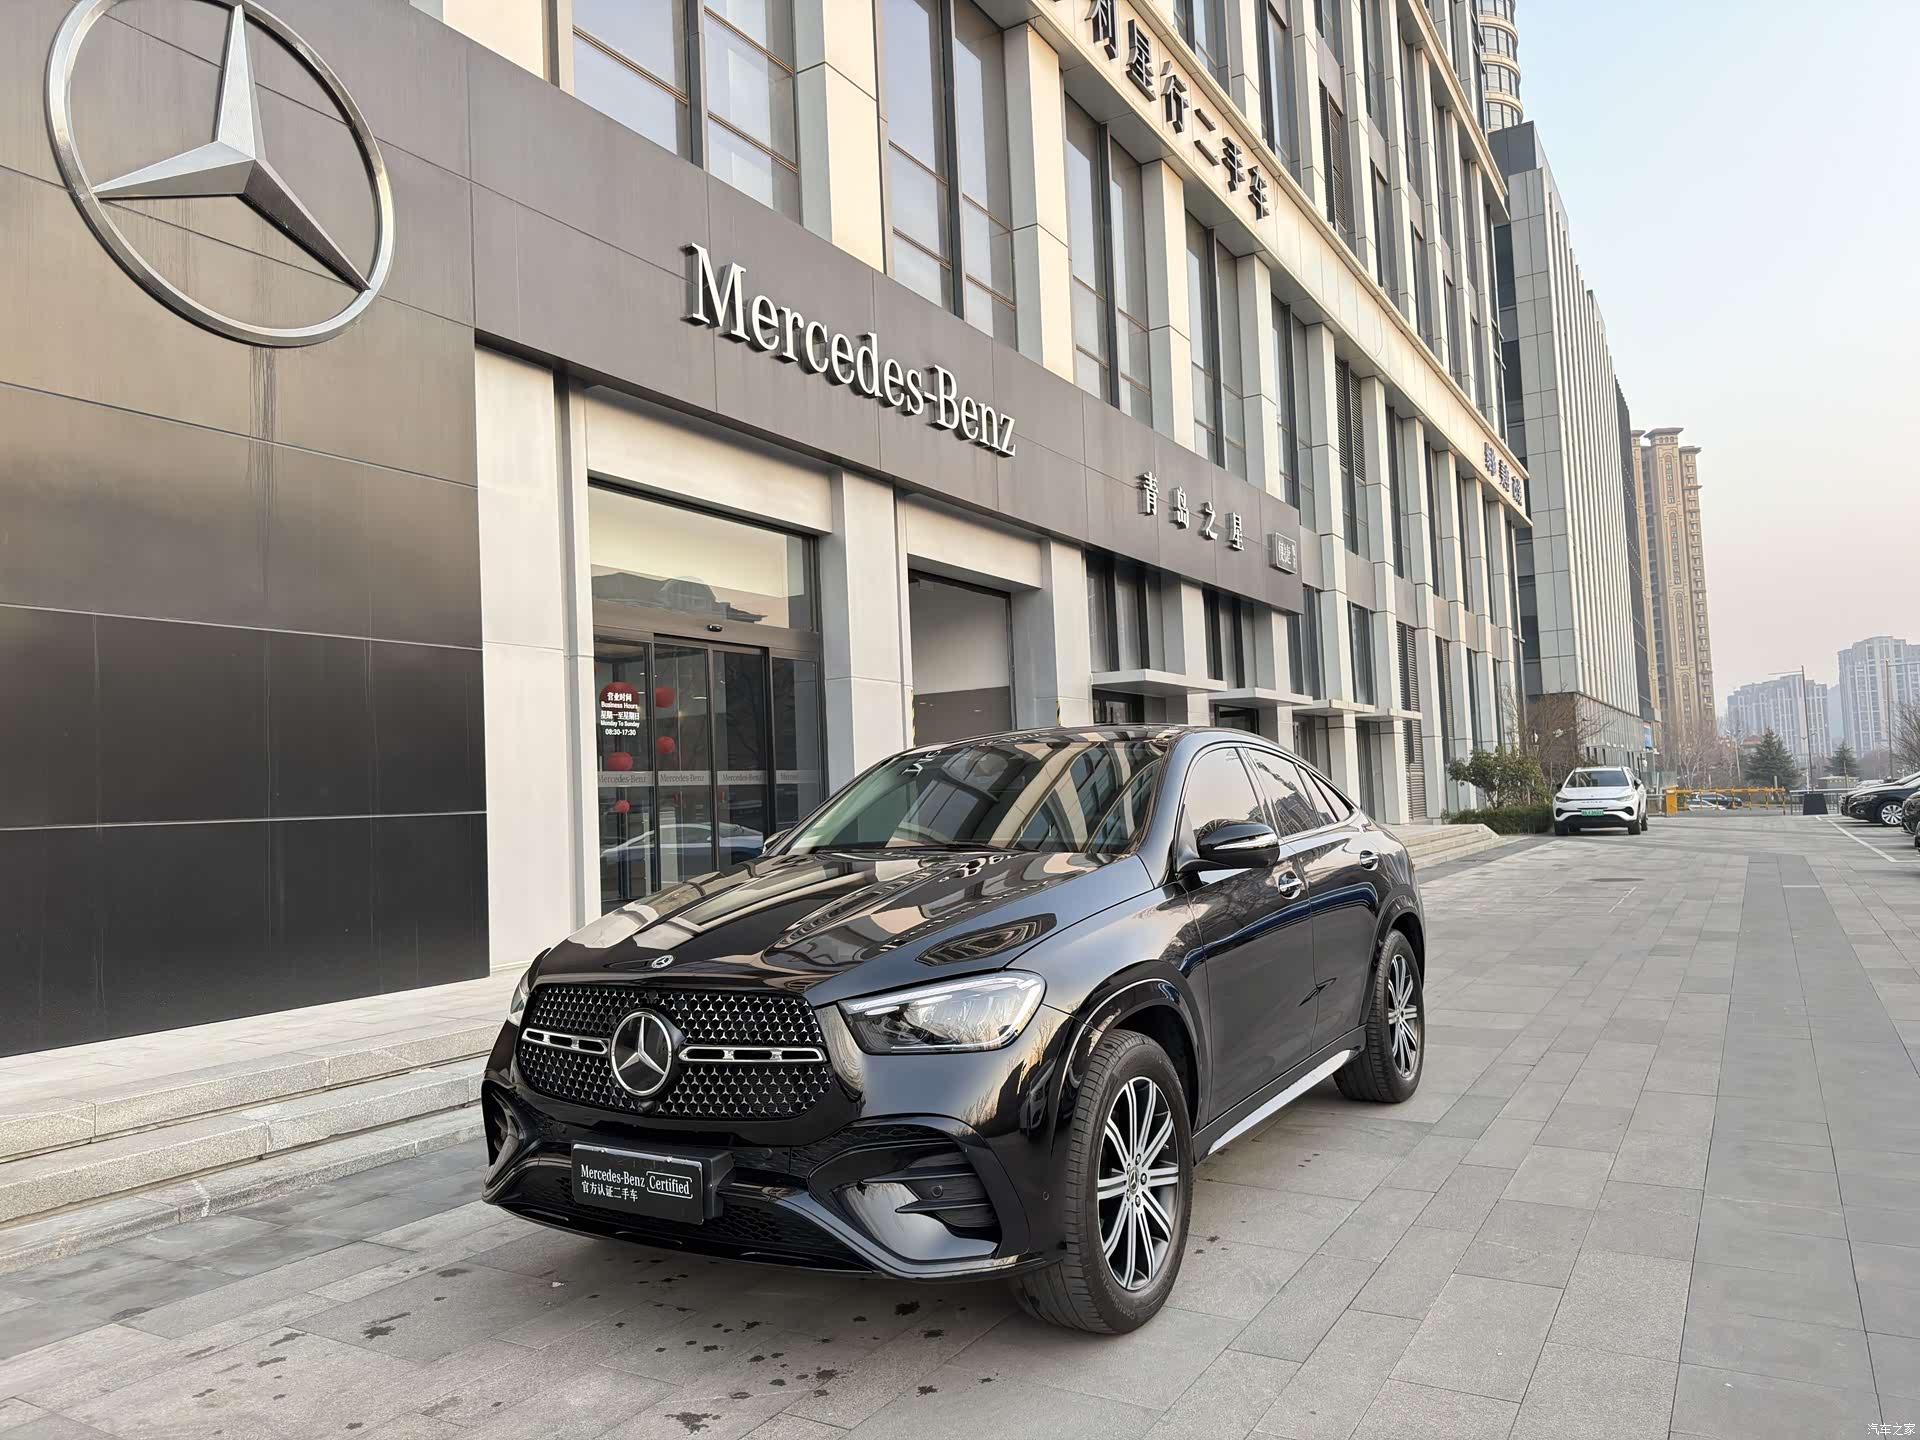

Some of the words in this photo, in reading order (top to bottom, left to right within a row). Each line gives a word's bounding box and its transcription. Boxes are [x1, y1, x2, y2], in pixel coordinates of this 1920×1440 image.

[1084, 0, 1270, 220] 利星行二手车
[682, 242, 1016, 457] Mercedes-Benz
[1142, 471, 1245, 551] 青岛之星
[607, 691, 632, 702] 营业时间
[600, 700, 623, 709] Business
[623, 702, 638, 710] Hours
[600, 709, 640, 721] 星期一至星期日
[600, 719, 618, 728] Monday
[624, 720, 640, 729] Sunday
[604, 728, 637, 736] 08:30-17:30
[660, 773, 705, 783] Mercedes-Benz
[580, 1164, 646, 1188] Mercedes-Benz
[649, 1175, 690, 1195] Certified
[581, 1180, 638, 1202] 官方认证二手车
